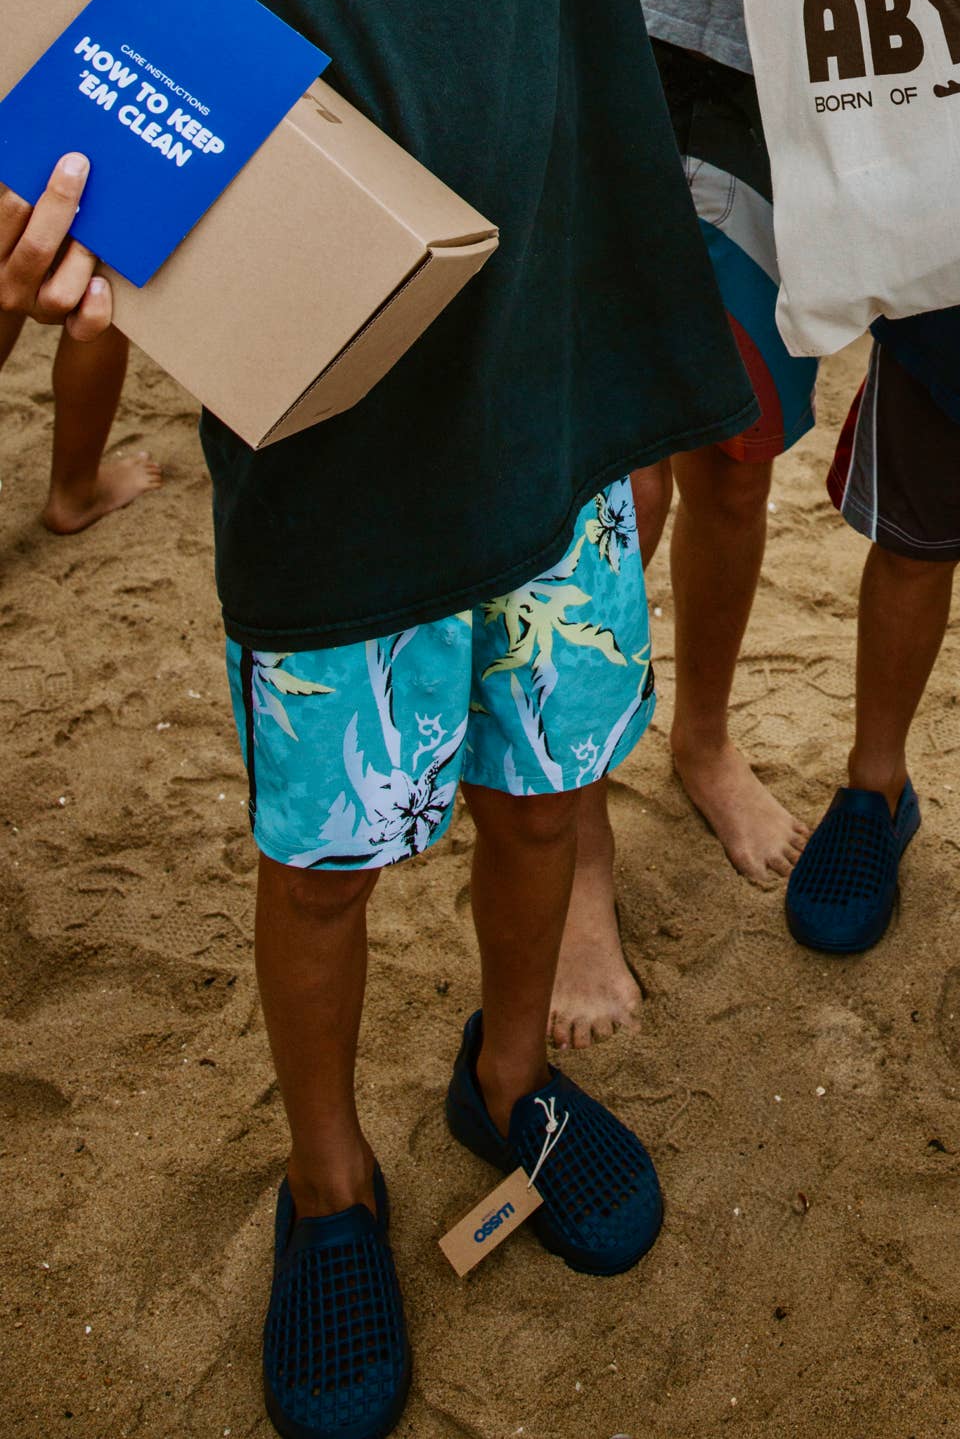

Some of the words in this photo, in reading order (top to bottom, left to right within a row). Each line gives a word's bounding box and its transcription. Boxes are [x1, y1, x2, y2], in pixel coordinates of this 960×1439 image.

[73, 36, 138, 89] HOW
[135, 81, 169, 114] TO
[166, 108, 225, 154] KEEP
[120, 44, 147, 67] CARE
[144, 62, 211, 116] INSTRUCTIONS
[815, 91, 873, 113] BORN
[890, 87, 918, 105] OF
[78, 69, 118, 111] 'EM
[118, 105, 193, 167] CLEAN
[473, 1201, 515, 1243] LUSSO
